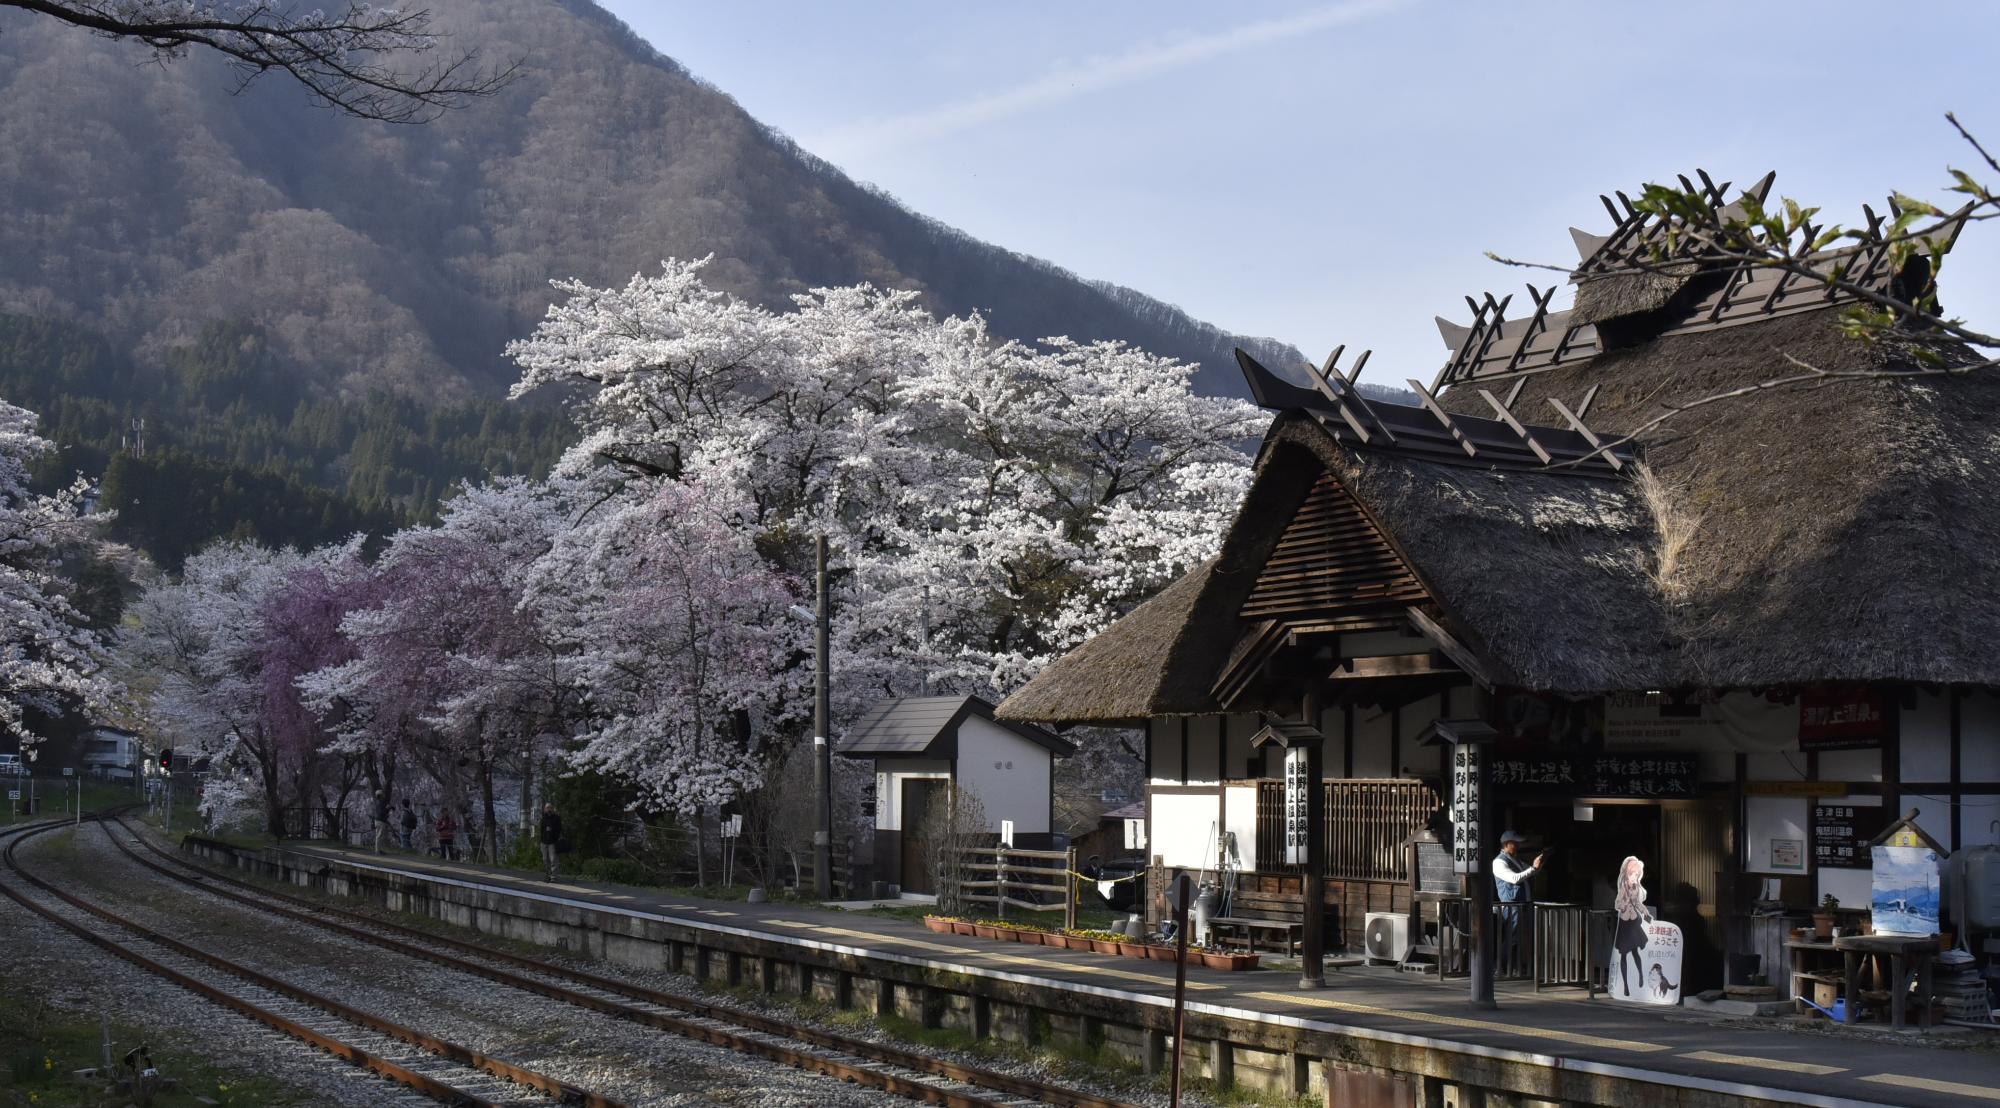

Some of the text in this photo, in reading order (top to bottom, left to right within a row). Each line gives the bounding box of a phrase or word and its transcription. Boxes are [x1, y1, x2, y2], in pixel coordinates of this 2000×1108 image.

[1492, 759, 1576, 784] 湯野上温泉
[1287, 761, 1296, 847] 湯野上温泉駅
[1456, 752, 1466, 862] 湯野上温泉駅
[1816, 807, 1854, 817] 会津田島
[1816, 826, 1854, 837] 鬼怒川温泉
[1816, 845, 1854, 857] 浅草・新宿
[1649, 926, 1679, 936] 会津鉄道へ
[1654, 937, 1679, 947] ようこそ
